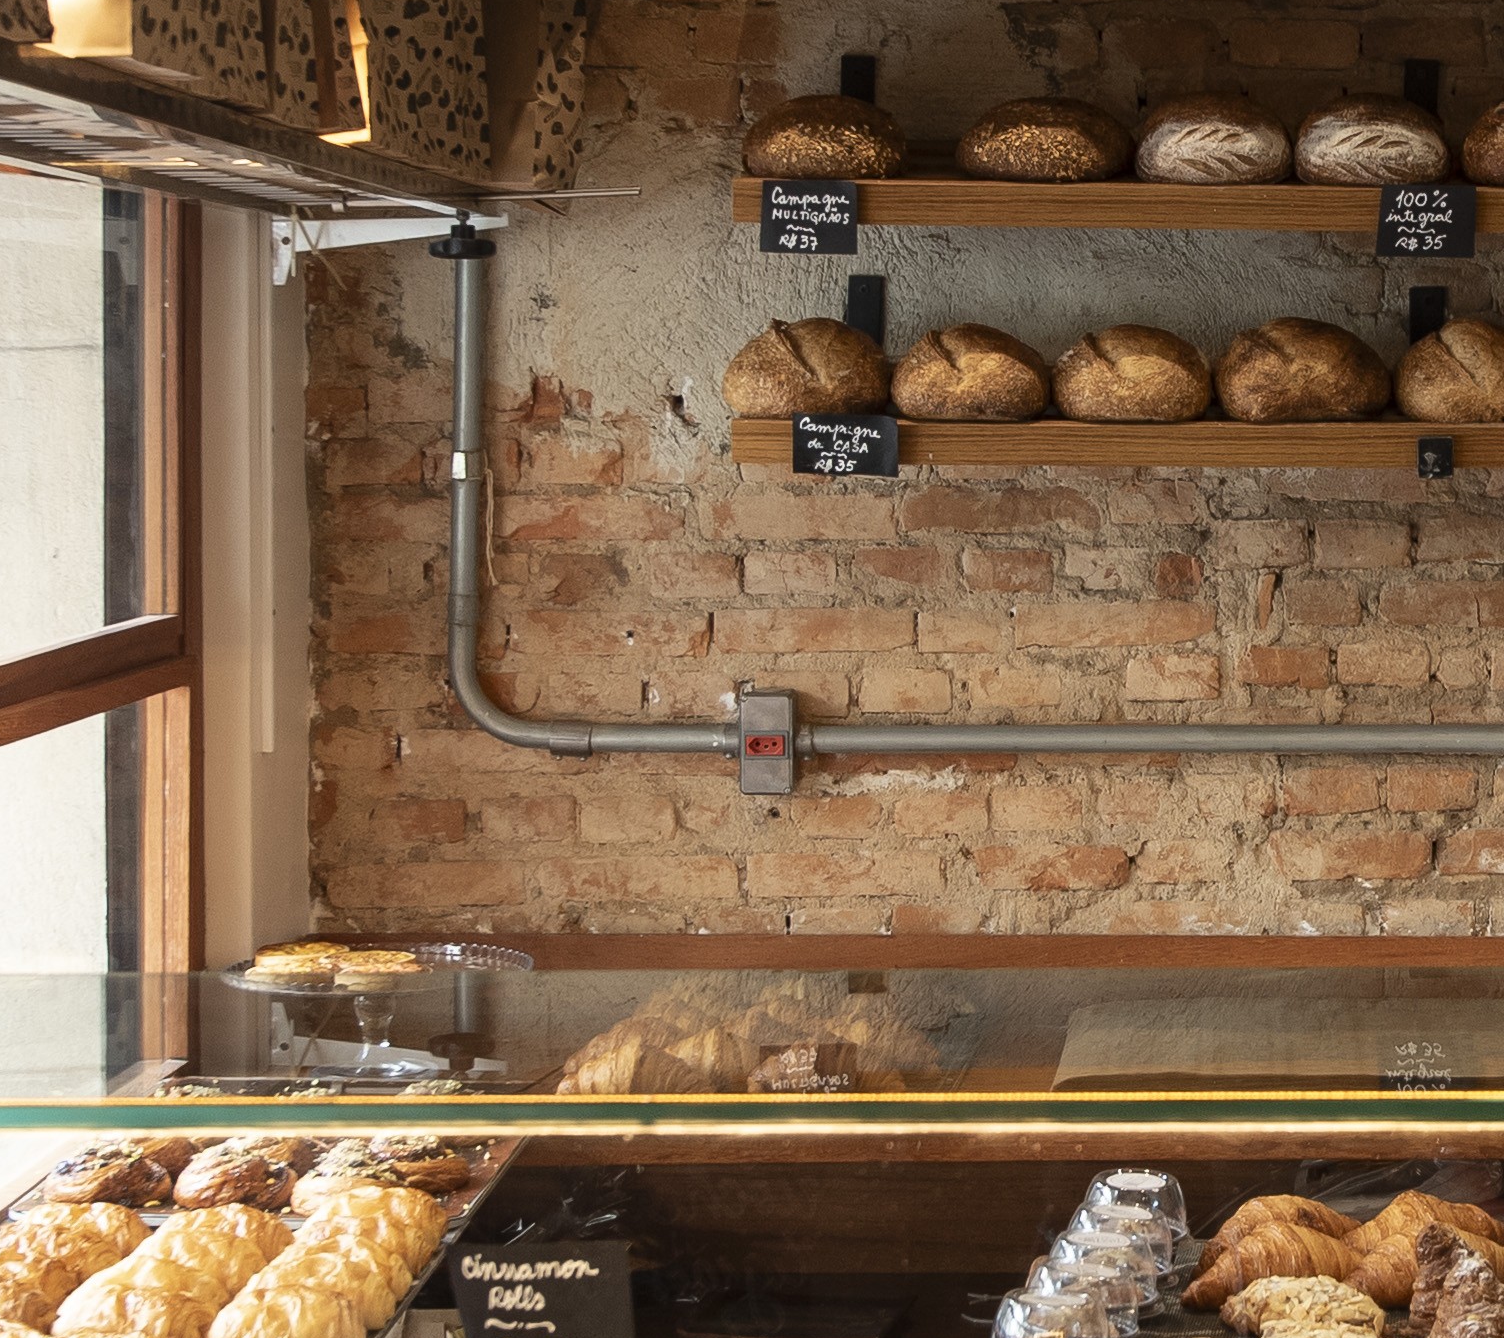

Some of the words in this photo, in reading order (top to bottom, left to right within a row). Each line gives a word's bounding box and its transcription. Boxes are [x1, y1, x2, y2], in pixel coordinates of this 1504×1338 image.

[771, 186, 849, 212] Campagne
[1385, 209, 1453, 229] integral
[779, 234, 797, 249] R$
[800, 235, 818, 251] 37
[1395, 237, 1418, 251] R$
[1422, 234, 1447, 250] 35
[807, 438, 824, 449] da
[833, 440, 869, 453] CASA
[814, 459, 833, 473] R$
[835, 459, 857, 472] 35
[461, 1253, 599, 1281] Cinnamon
[488, 1284, 546, 1311] Rolls
